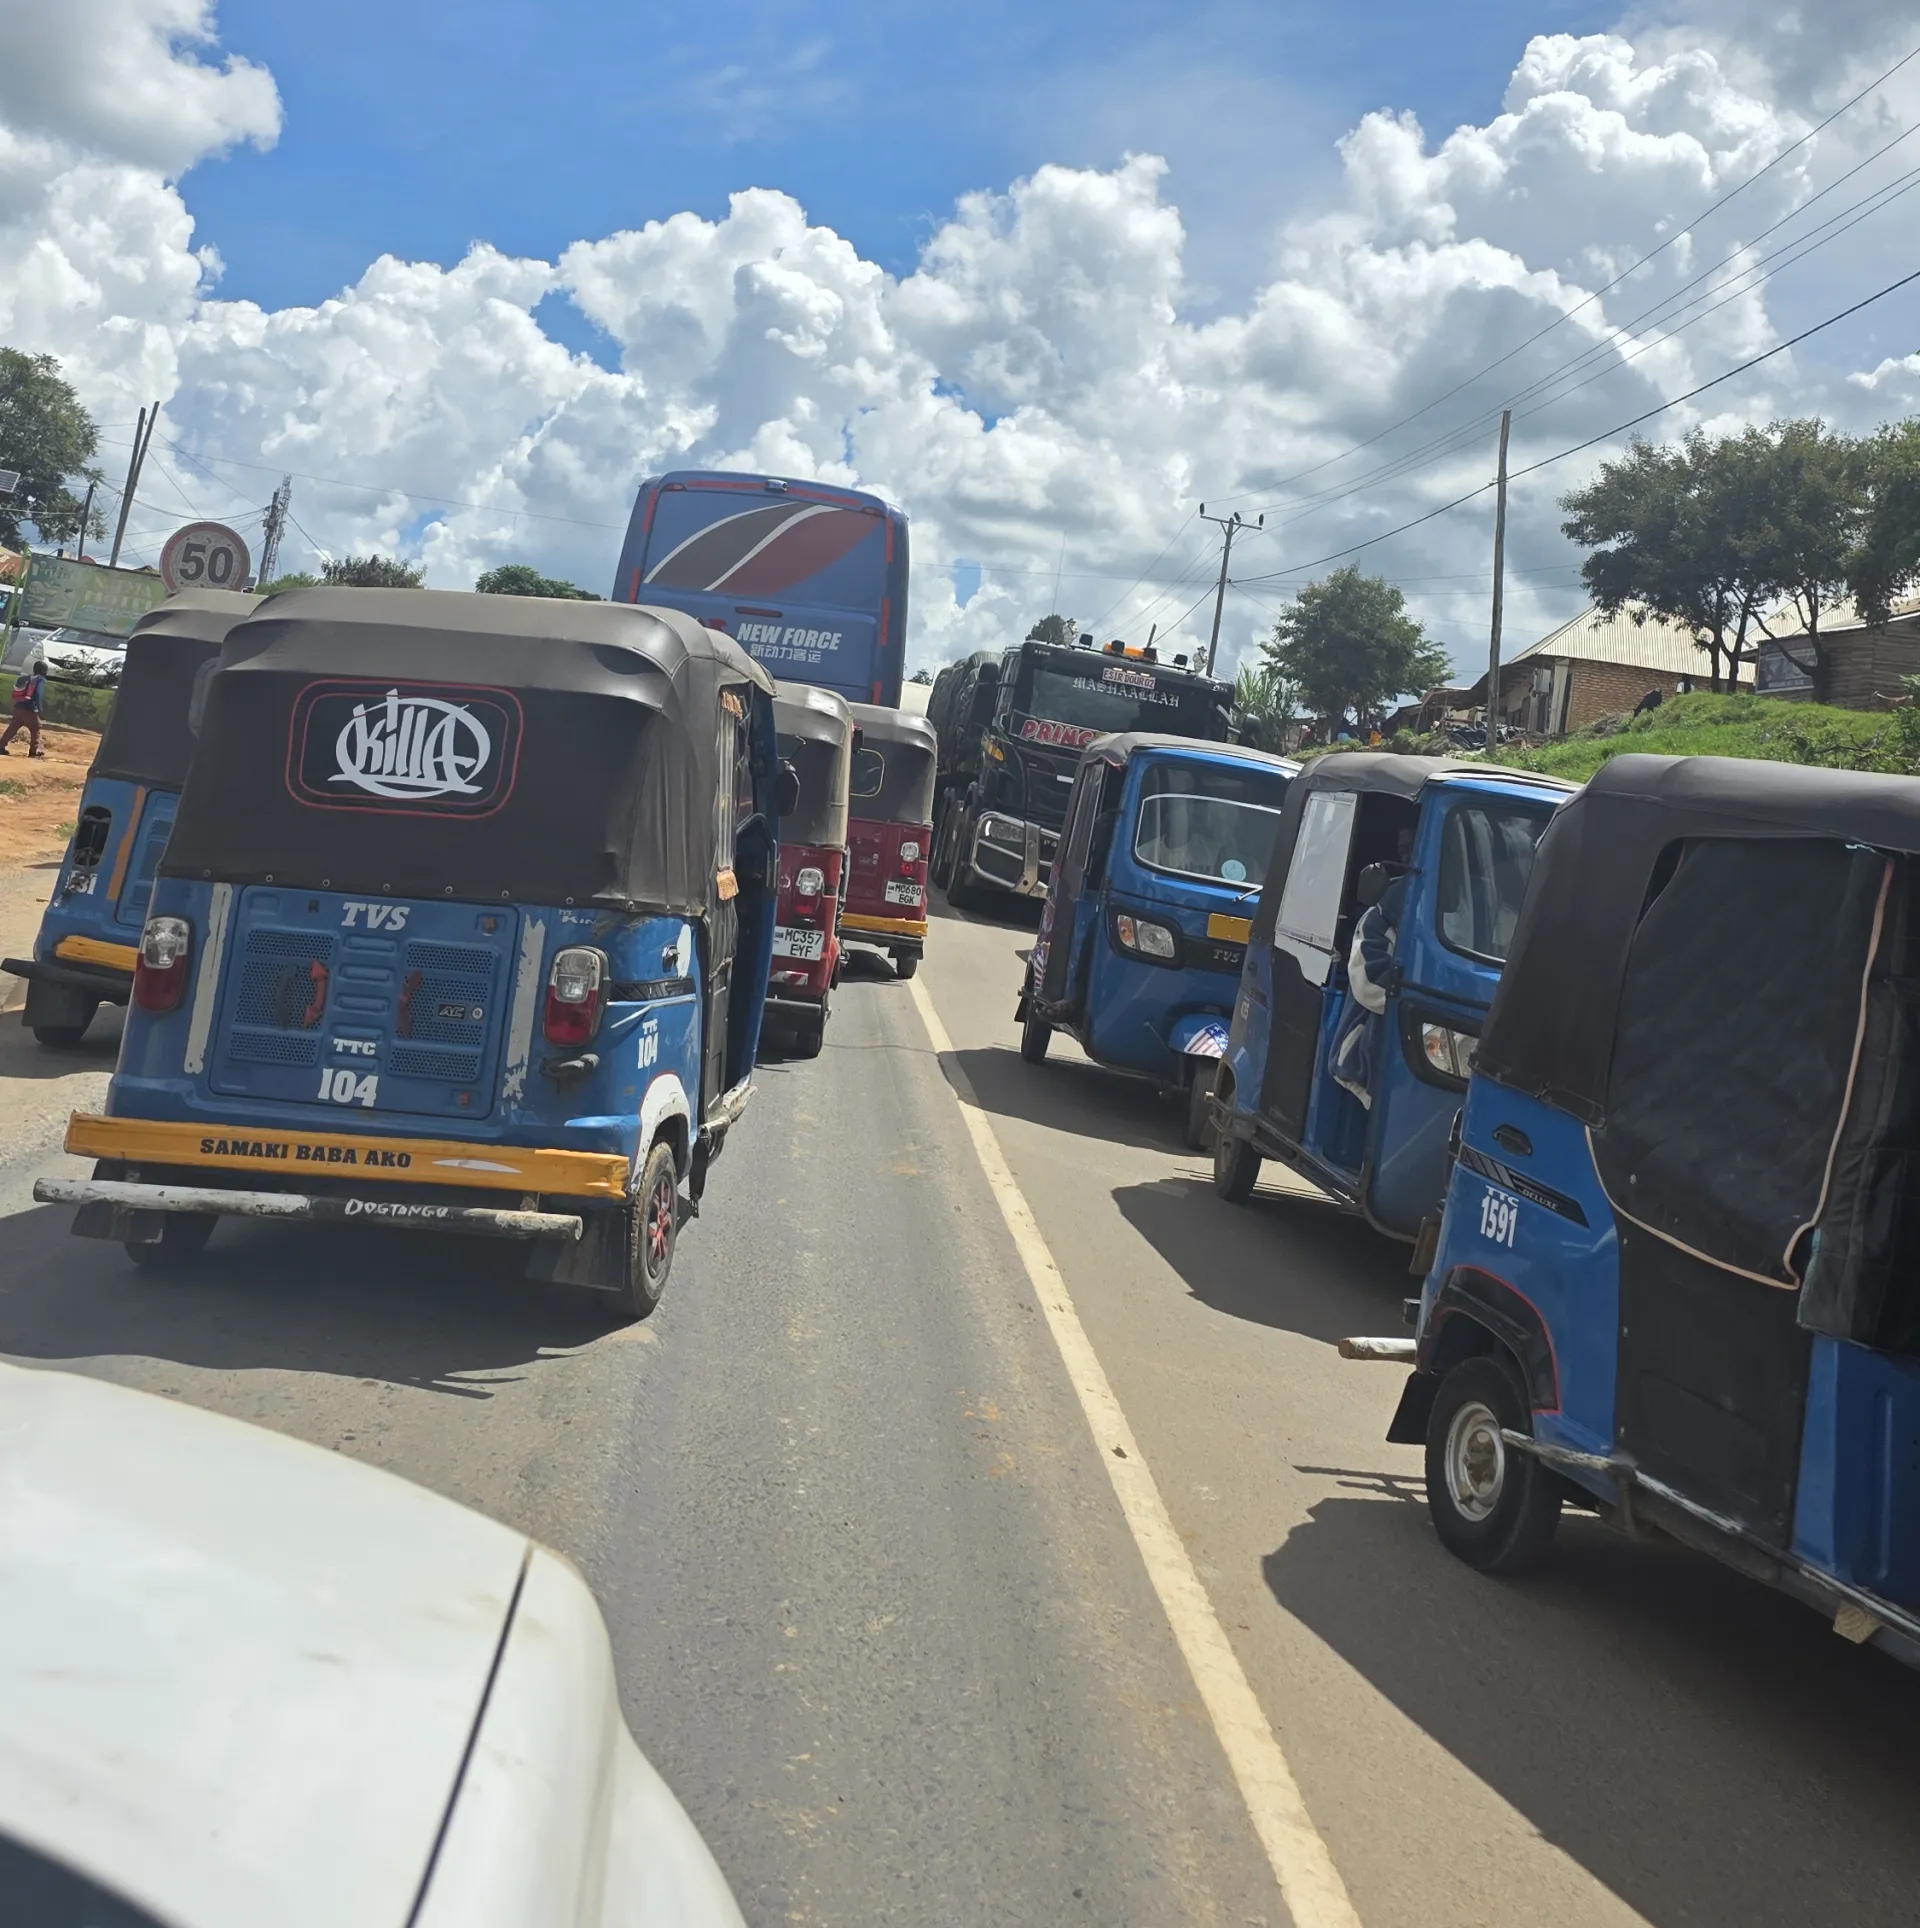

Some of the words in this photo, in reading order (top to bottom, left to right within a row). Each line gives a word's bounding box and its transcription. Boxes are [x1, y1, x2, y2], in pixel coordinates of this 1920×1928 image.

[179, 542, 233, 583] 50
[737, 623, 782, 644] NEW
[782, 628, 842, 650] FORCE
[894, 883, 922, 896] MC680
[341, 902, 410, 931] TVS
[785, 929, 822, 945] MC357
[789, 943, 813, 958] EYF
[1213, 949, 1240, 963] TVS
[333, 1038, 376, 1055] TTC
[637, 1032, 658, 1069] 104
[318, 1068, 379, 1107] 104
[200, 1138, 290, 1159] SAMAKI
[295, 1144, 357, 1164] BABA
[364, 1150, 412, 1168] AKO
[1485, 1184, 1520, 1208] TTC
[1521, 1187, 1561, 1211] DELUXE
[1480, 1195, 1518, 1248] 1591
